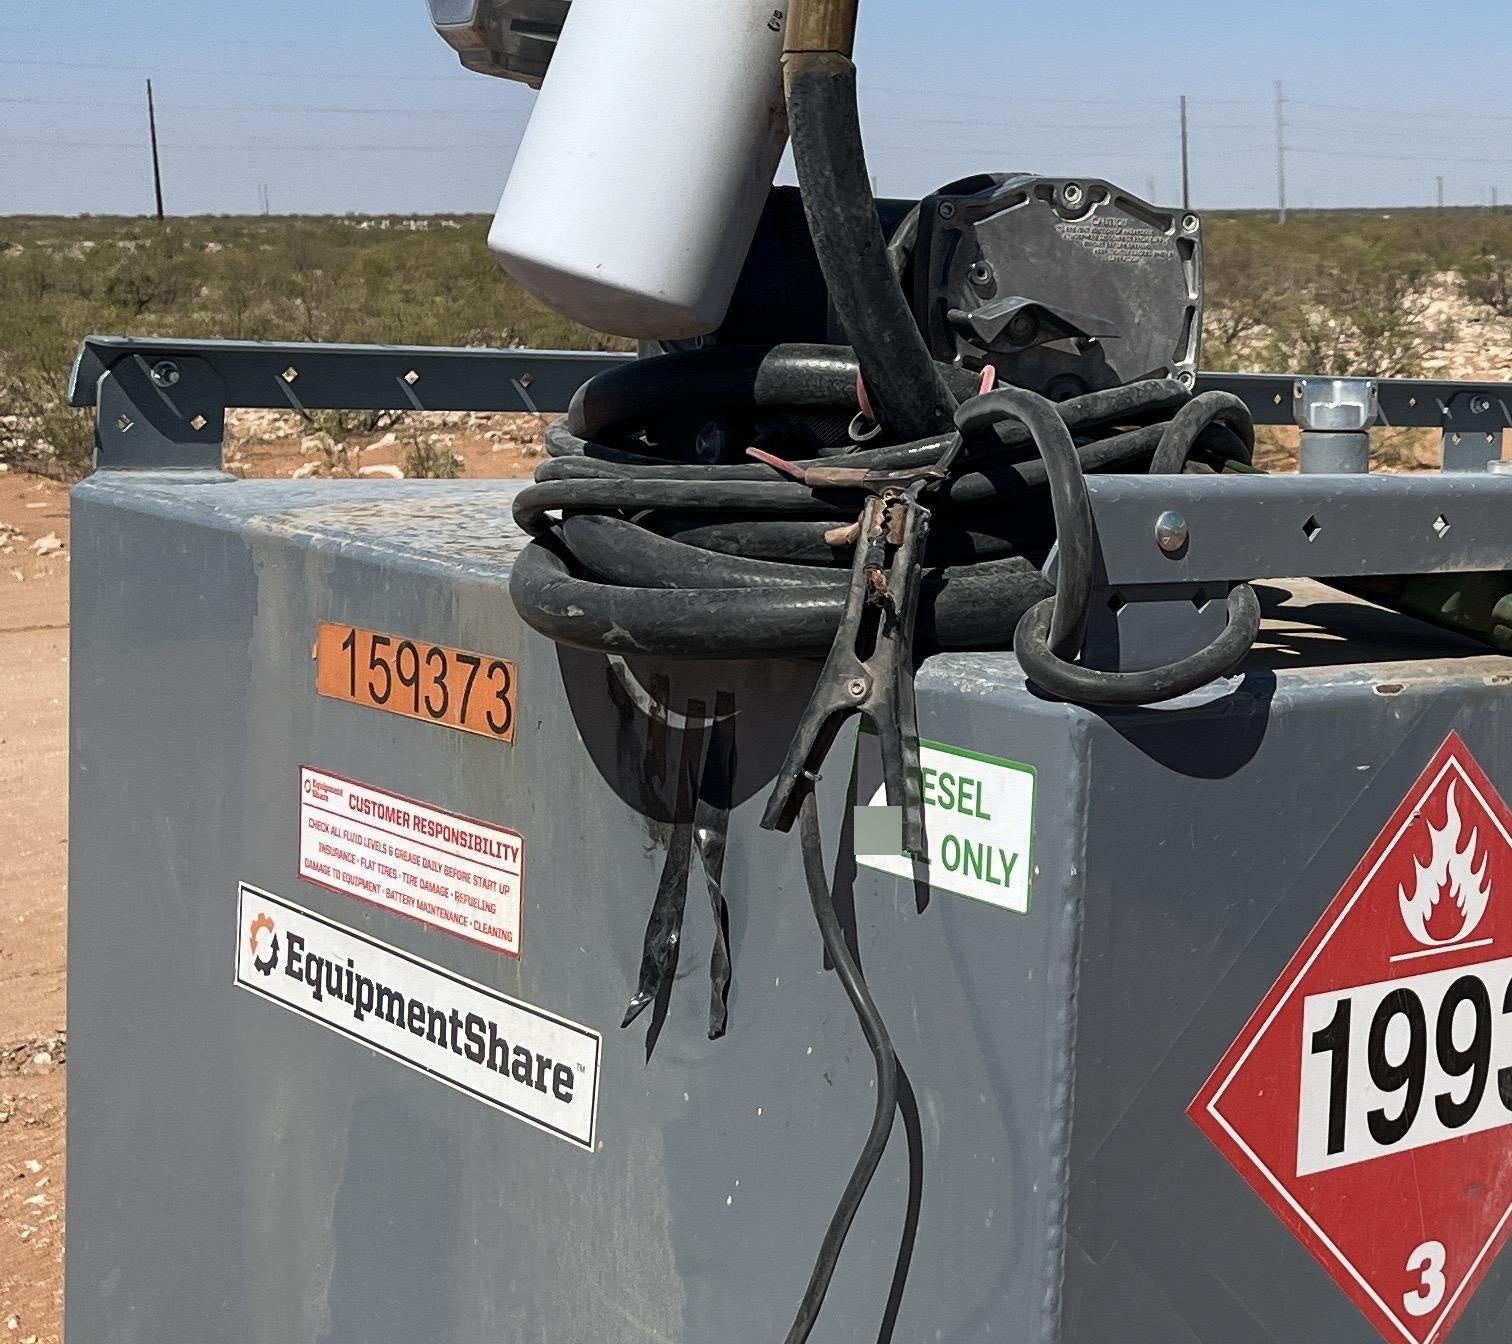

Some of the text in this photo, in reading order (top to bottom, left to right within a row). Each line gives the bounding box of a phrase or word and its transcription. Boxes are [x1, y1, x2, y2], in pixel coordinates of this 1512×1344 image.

[341, 628, 513, 735] 159373
[349, 793, 519, 863] CUSTOMER RESPONSIBILITY
[922, 767, 991, 821] ESEL
[309, 818, 329, 833] CHECK
[331, 825, 341, 838] ALL
[343, 830, 362, 845] FLUID
[364, 837, 386, 854] LEVELS
[395, 848, 420, 866] GREASE
[422, 857, 442, 873] DAILY
[444, 864, 471, 884] BEFORE
[473, 876, 496, 892] START
[499, 883, 510, 896] UP
[319, 842, 496, 914] INSURANCE FLAT TIRES TIRE DAMAGE REFUELING
[941, 834, 1019, 888] ONLY
[305, 857, 513, 942] DAMAGE TO EQUIPMENT BATTERY MAINTENANCE CLEANING
[285, 930, 575, 1104] EquipmentShare
[1403, 1240, 1446, 1317] 3
